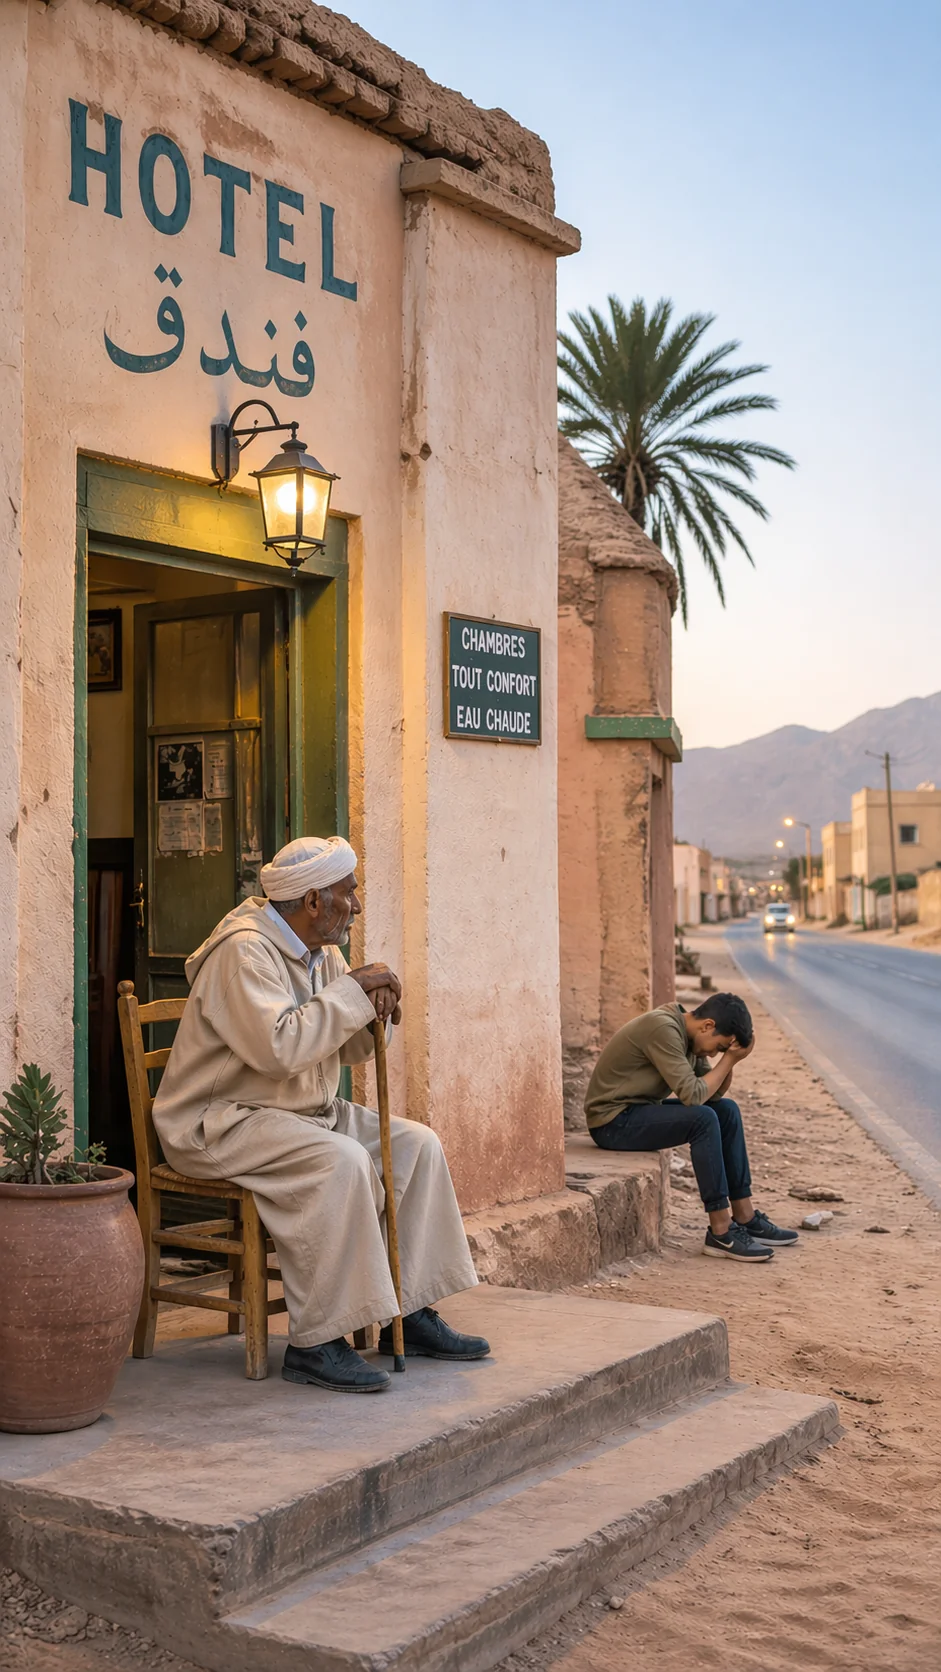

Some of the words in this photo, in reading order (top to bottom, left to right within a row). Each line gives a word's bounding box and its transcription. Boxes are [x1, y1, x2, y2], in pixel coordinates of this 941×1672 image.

[68, 97, 358, 302] HOTEL
[104, 263, 315, 397] فندق
[461, 626, 526, 658] CHAMBRES
[452, 664, 482, 690] TOUT
[486, 669, 537, 697] CONFORT
[456, 705, 481, 729] EAU
[486, 708, 531, 734] CHAUDE
